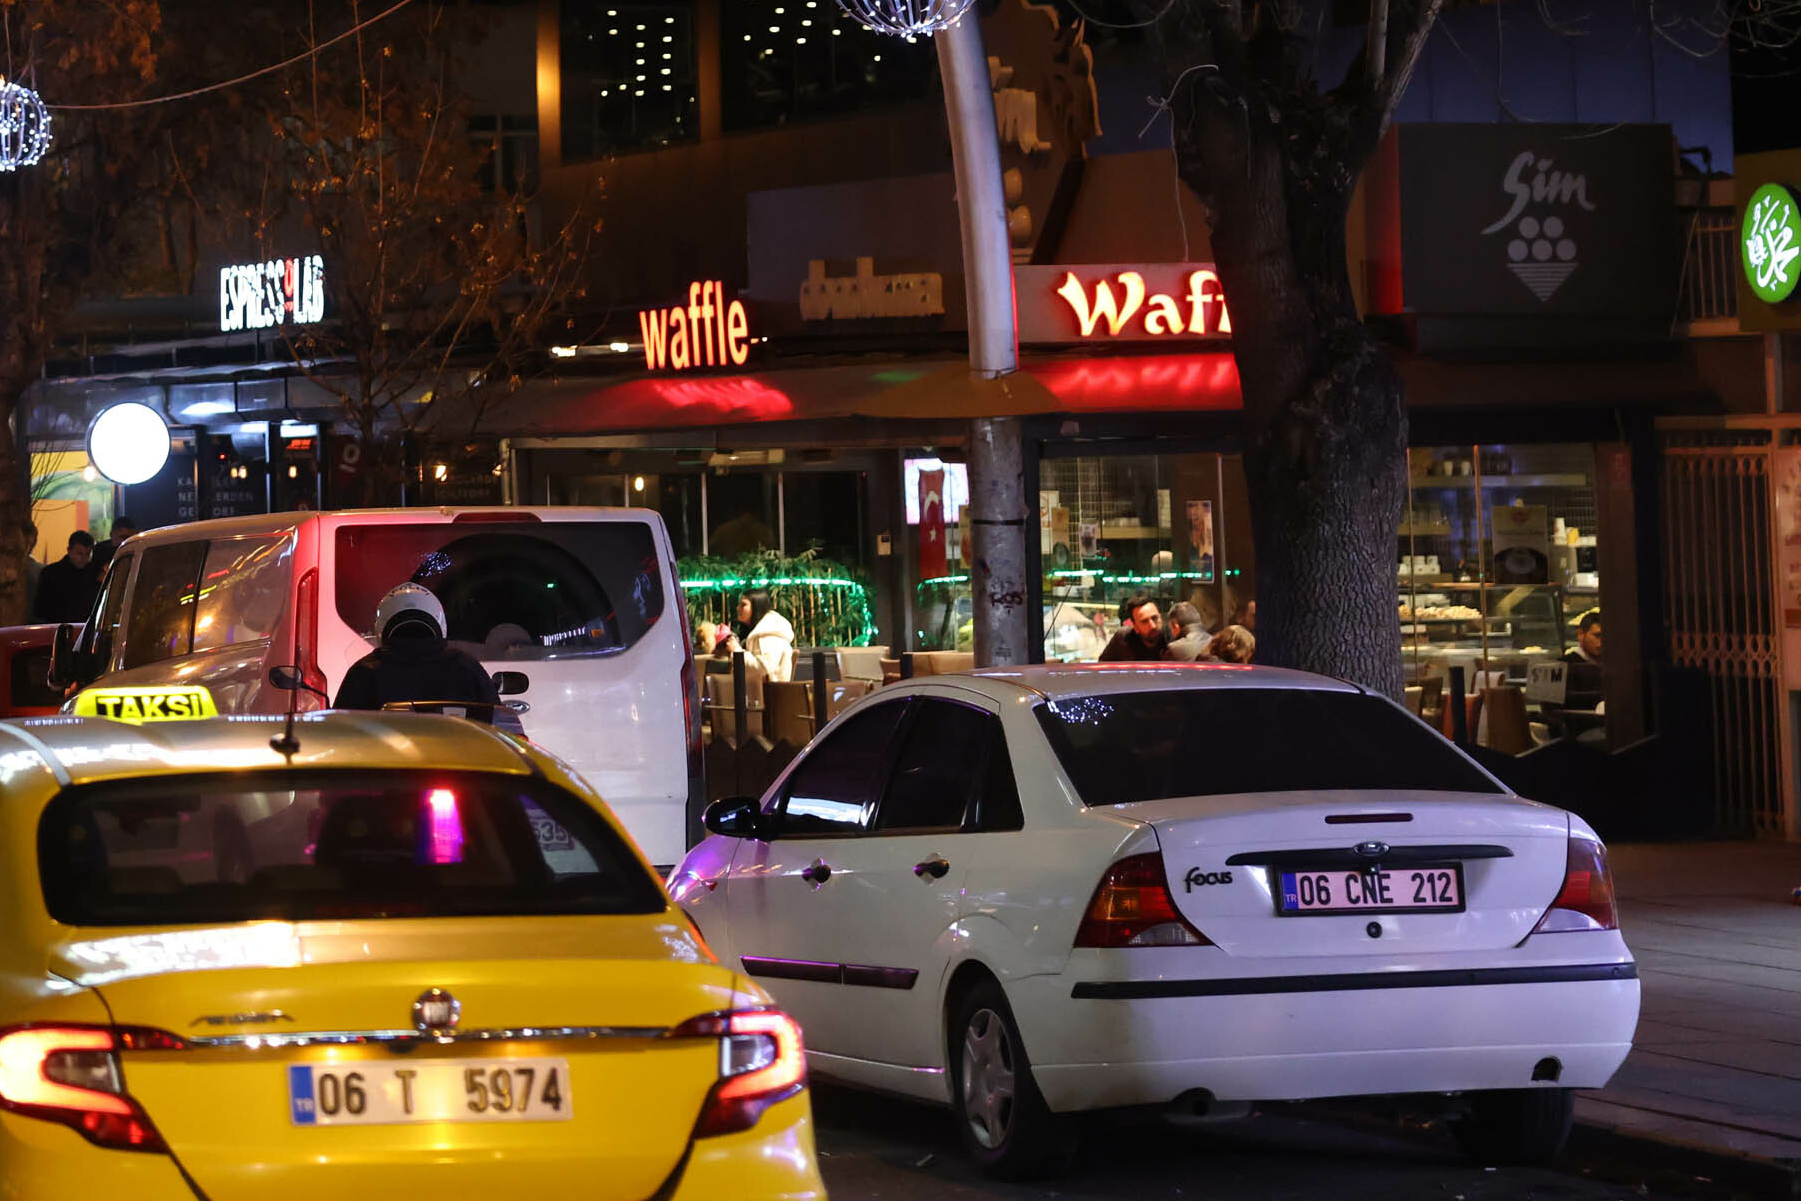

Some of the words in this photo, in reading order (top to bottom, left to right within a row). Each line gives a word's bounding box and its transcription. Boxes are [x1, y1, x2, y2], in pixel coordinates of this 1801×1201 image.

[1480, 151, 1595, 235] Sim
[639, 279, 749, 370] waffle
[1184, 866, 1233, 894] focus
[1299, 874, 1331, 906] 06
[1345, 872, 1394, 905] CNE
[1411, 871, 1453, 904] 212
[318, 1072, 367, 1116] 06
[395, 1070, 417, 1115] T
[464, 1067, 562, 1113] 5974
